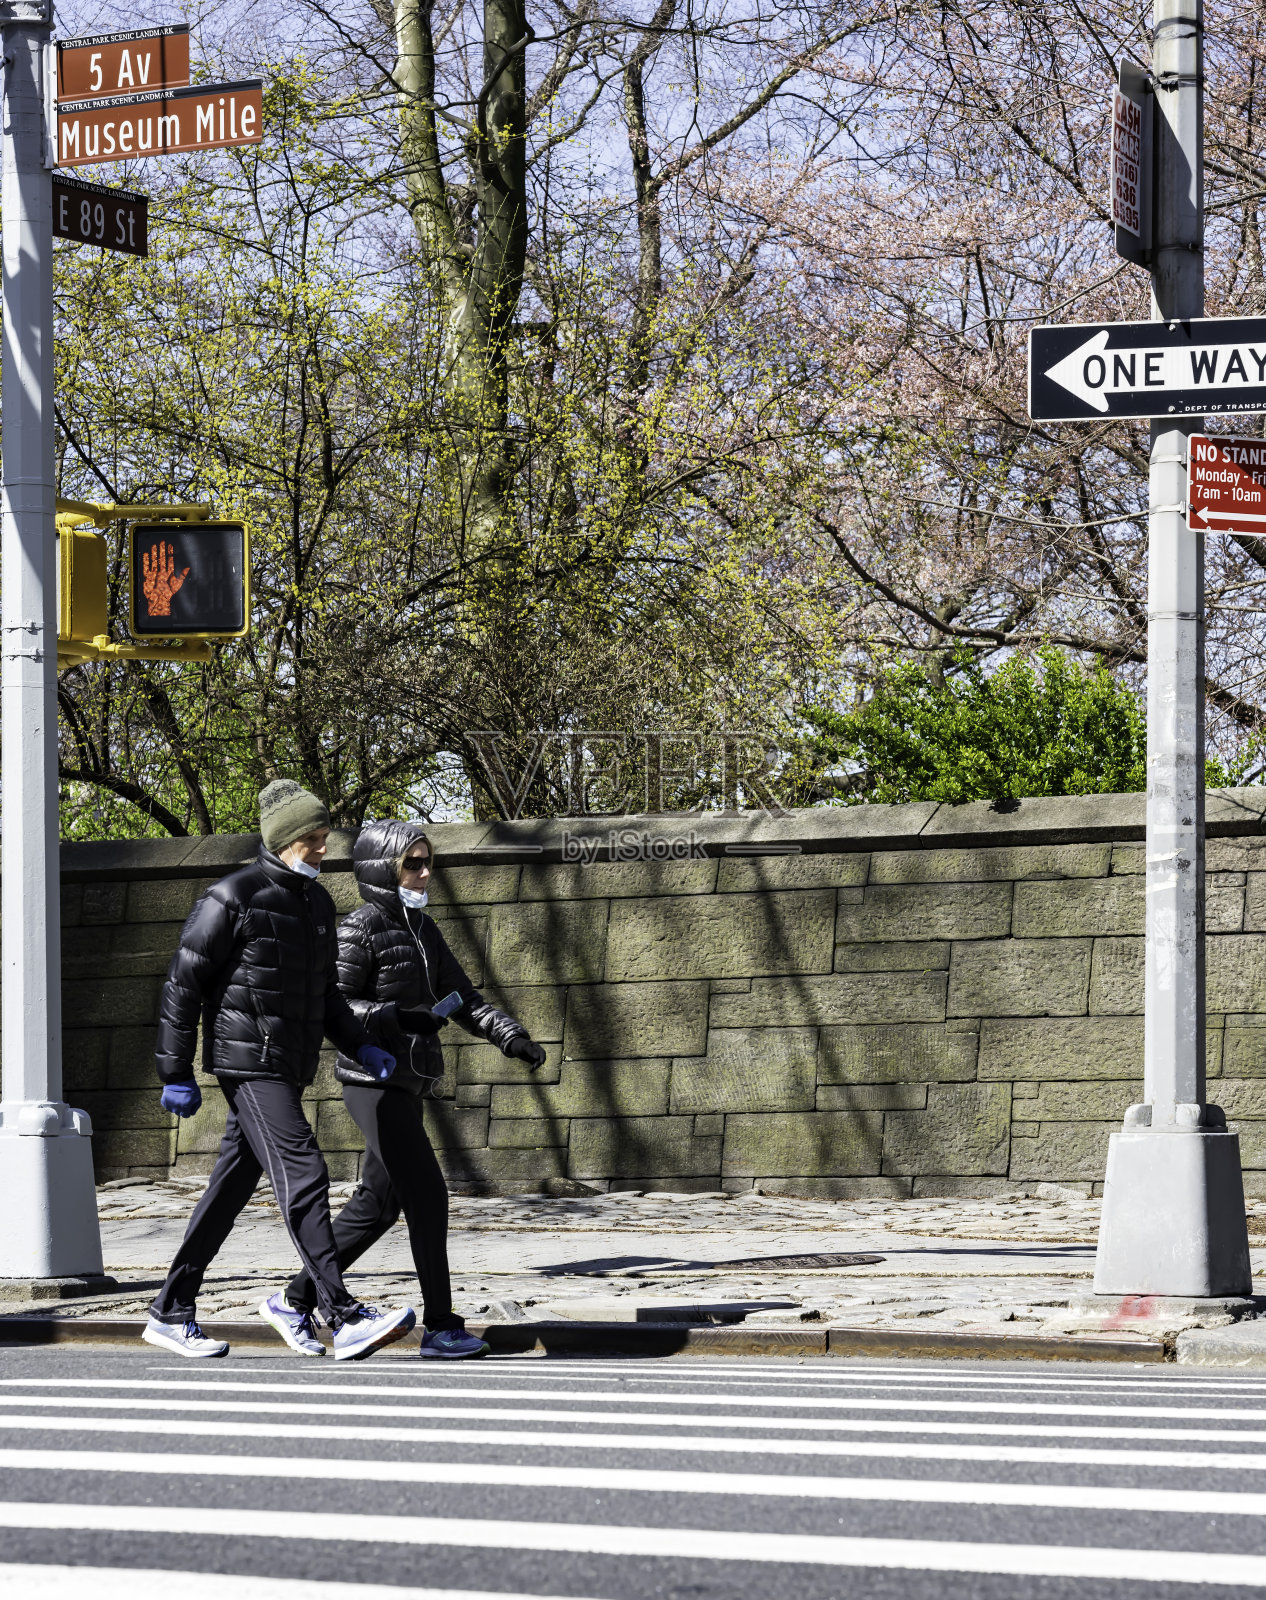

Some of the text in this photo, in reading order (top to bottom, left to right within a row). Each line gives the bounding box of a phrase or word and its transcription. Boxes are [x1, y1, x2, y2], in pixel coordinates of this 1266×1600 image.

[61, 27, 174, 49] CENTRAL PARK SCENIC LANDMARK
[90, 49, 151, 91] 5 Av
[61, 90, 175, 112] CENTRAL PARK SCENIC LANDMARK
[62, 97, 256, 160] Museum Mile
[1114, 154, 1138, 186] (516)
[53, 176, 136, 202] CENTRAL PARK SCENIC LANDMARK
[1116, 178, 1136, 207] 636
[60, 194, 136, 248] E 89 St
[1083, 348, 1266, 389] ONE WAY
[1185, 404, 1207, 413] DEPT
[1211, 403, 1222, 411] OF
[1196, 444, 1218, 463] NO
[1196, 467, 1241, 487] Monday
[1251, 471, 1266, 485] Fri
[1196, 484, 1221, 500] 7am
[1231, 487, 1262, 503] 10am
